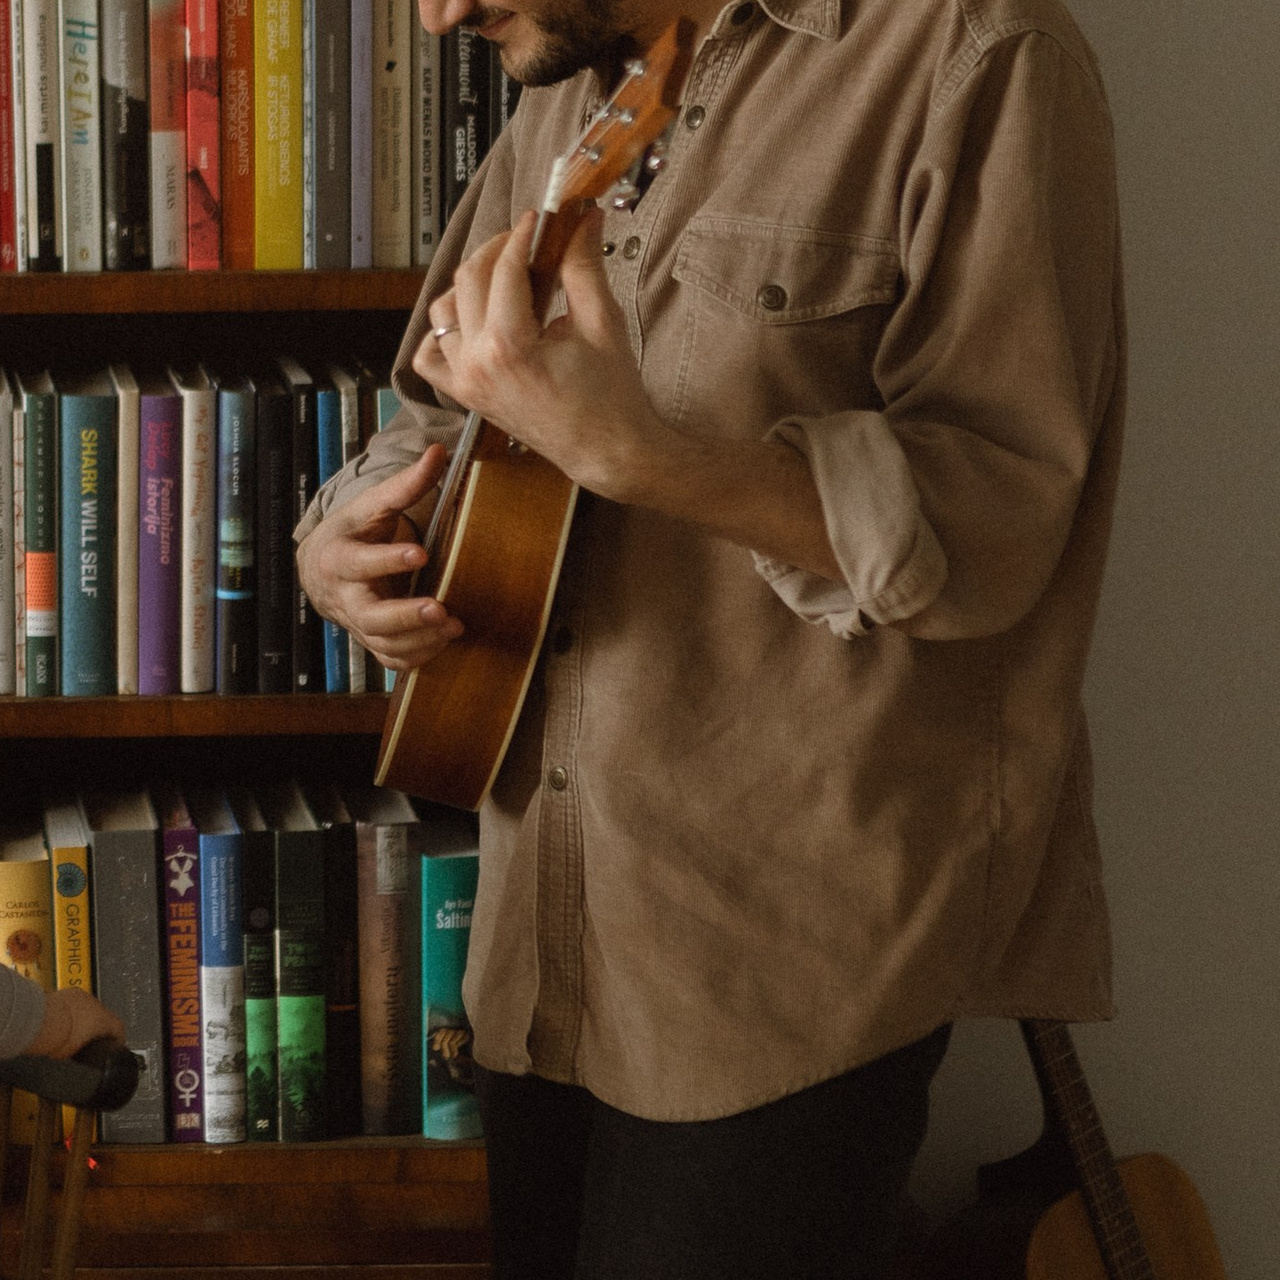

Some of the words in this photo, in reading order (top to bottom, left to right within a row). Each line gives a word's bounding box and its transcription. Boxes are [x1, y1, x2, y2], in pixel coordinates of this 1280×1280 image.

[267, 0, 278, 17] DE
[279, 0, 289, 49] REINIER
[66, 18, 98, 85] Here
[267, 19, 278, 64] GRAAF
[67, 85, 92, 104] I
[267, 75, 278, 87] IR
[422, 67, 432, 94] KAIP
[71, 107, 93, 145] Am
[226, 69, 238, 140] NIUJORKAS
[237, 69, 250, 176] KARŠČIUOJANTIS
[266, 90, 278, 140] STOGAS
[279, 74, 290, 136] KETURIOS
[422, 97, 432, 136] MENAS
[279, 139, 290, 186] SIENOS
[422, 139, 432, 174] MOKO
[165, 165, 176, 210] MARAS
[422, 176, 432, 217] MATYTI
[146, 422, 161, 471] Delap
[159, 421, 174, 458] Lucy
[231, 415, 241, 454] JOSHUA
[79, 428, 99, 495] SHARK
[232, 456, 241, 496] SLOCUM
[80, 498, 98, 547] WILL
[143, 477, 160, 535] istorija
[160, 477, 174, 565] Feminizmo
[81, 551, 99, 599] SELF
[3, 899, 40, 909] CARLOS
[169, 902, 197, 919] THE
[65, 903, 82, 974] GRAPHIC
[169, 918, 200, 1035] FEMINISM
